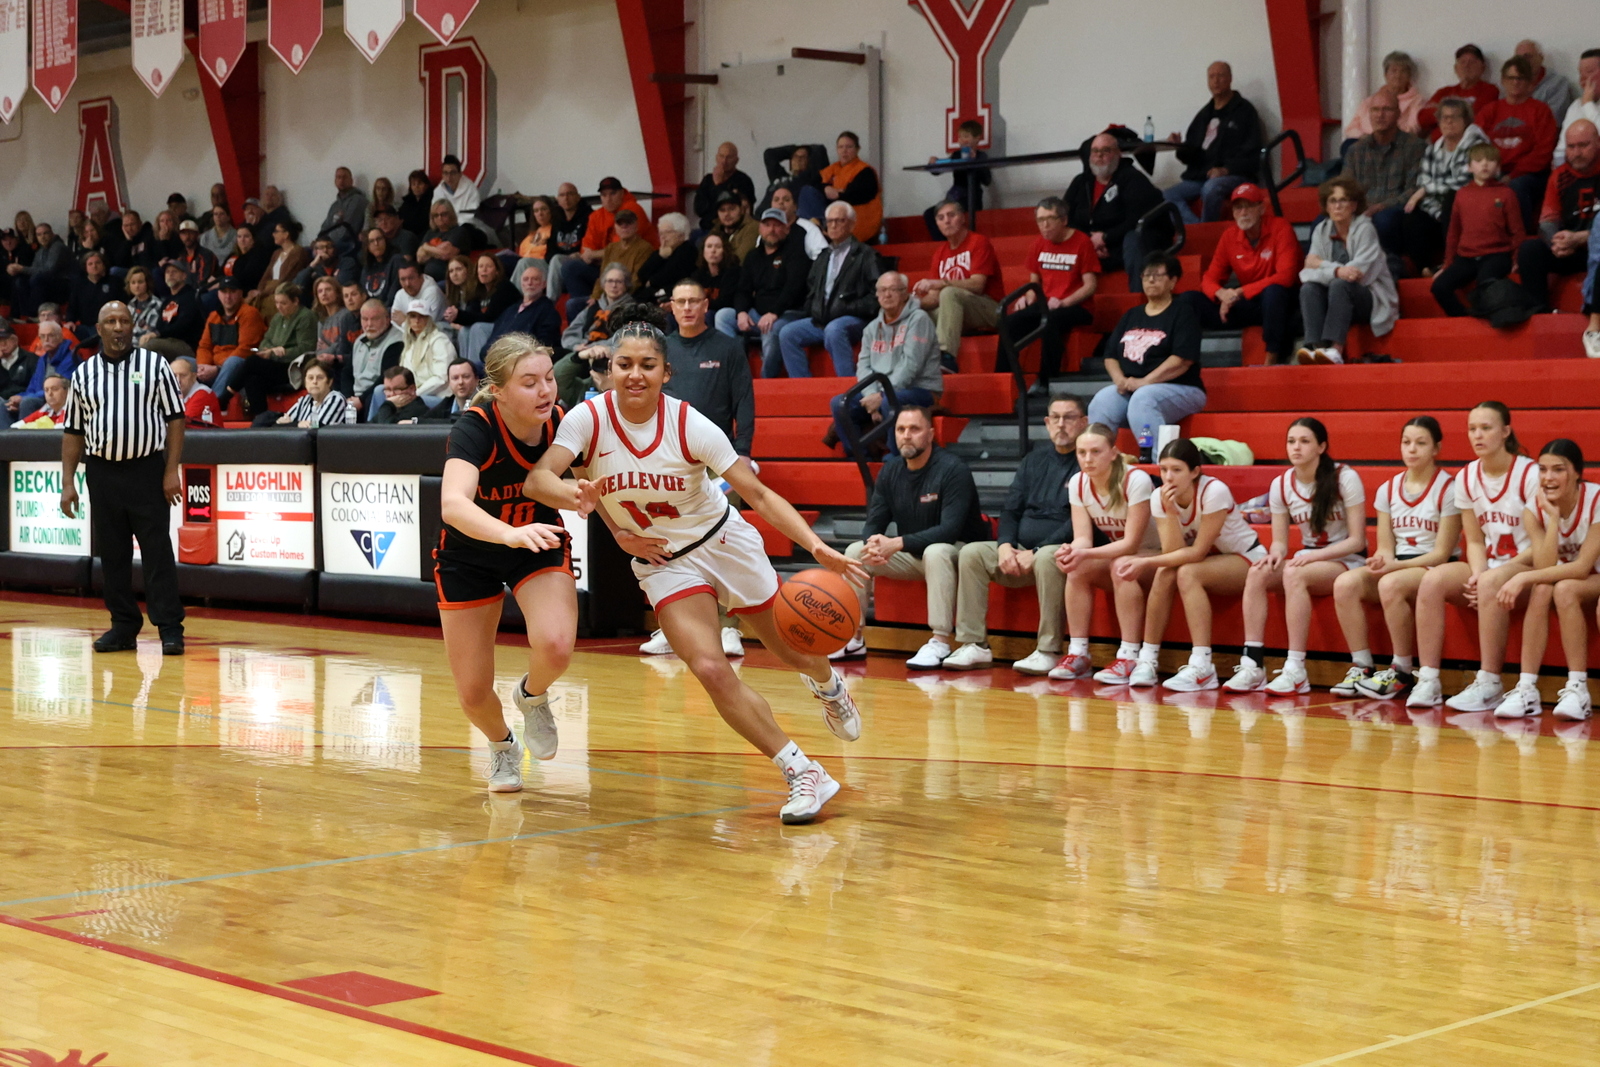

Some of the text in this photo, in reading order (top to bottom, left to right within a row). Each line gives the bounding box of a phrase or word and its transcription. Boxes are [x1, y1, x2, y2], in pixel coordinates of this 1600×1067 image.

[72, 96, 128, 219] A
[419, 36, 488, 189] D
[14, 470, 86, 495] BECKLY
[226, 471, 302, 491] LAUGHLIN
[188, 485, 211, 504] POSS
[228, 492, 301, 502] OUTDOOR LIVING
[330, 481, 414, 505] CROGHAN
[477, 482, 525, 501] LADY
[16, 500, 49, 518] PLUMB
[386, 510, 415, 525] BANK
[499, 501, 536, 528] 10
[19, 526, 82, 546] AIR CONDITIONING
[270, 535, 281, 547] Up
[250, 548, 305, 560] Custom Homes
[795, 589, 846, 625] Rawlings
